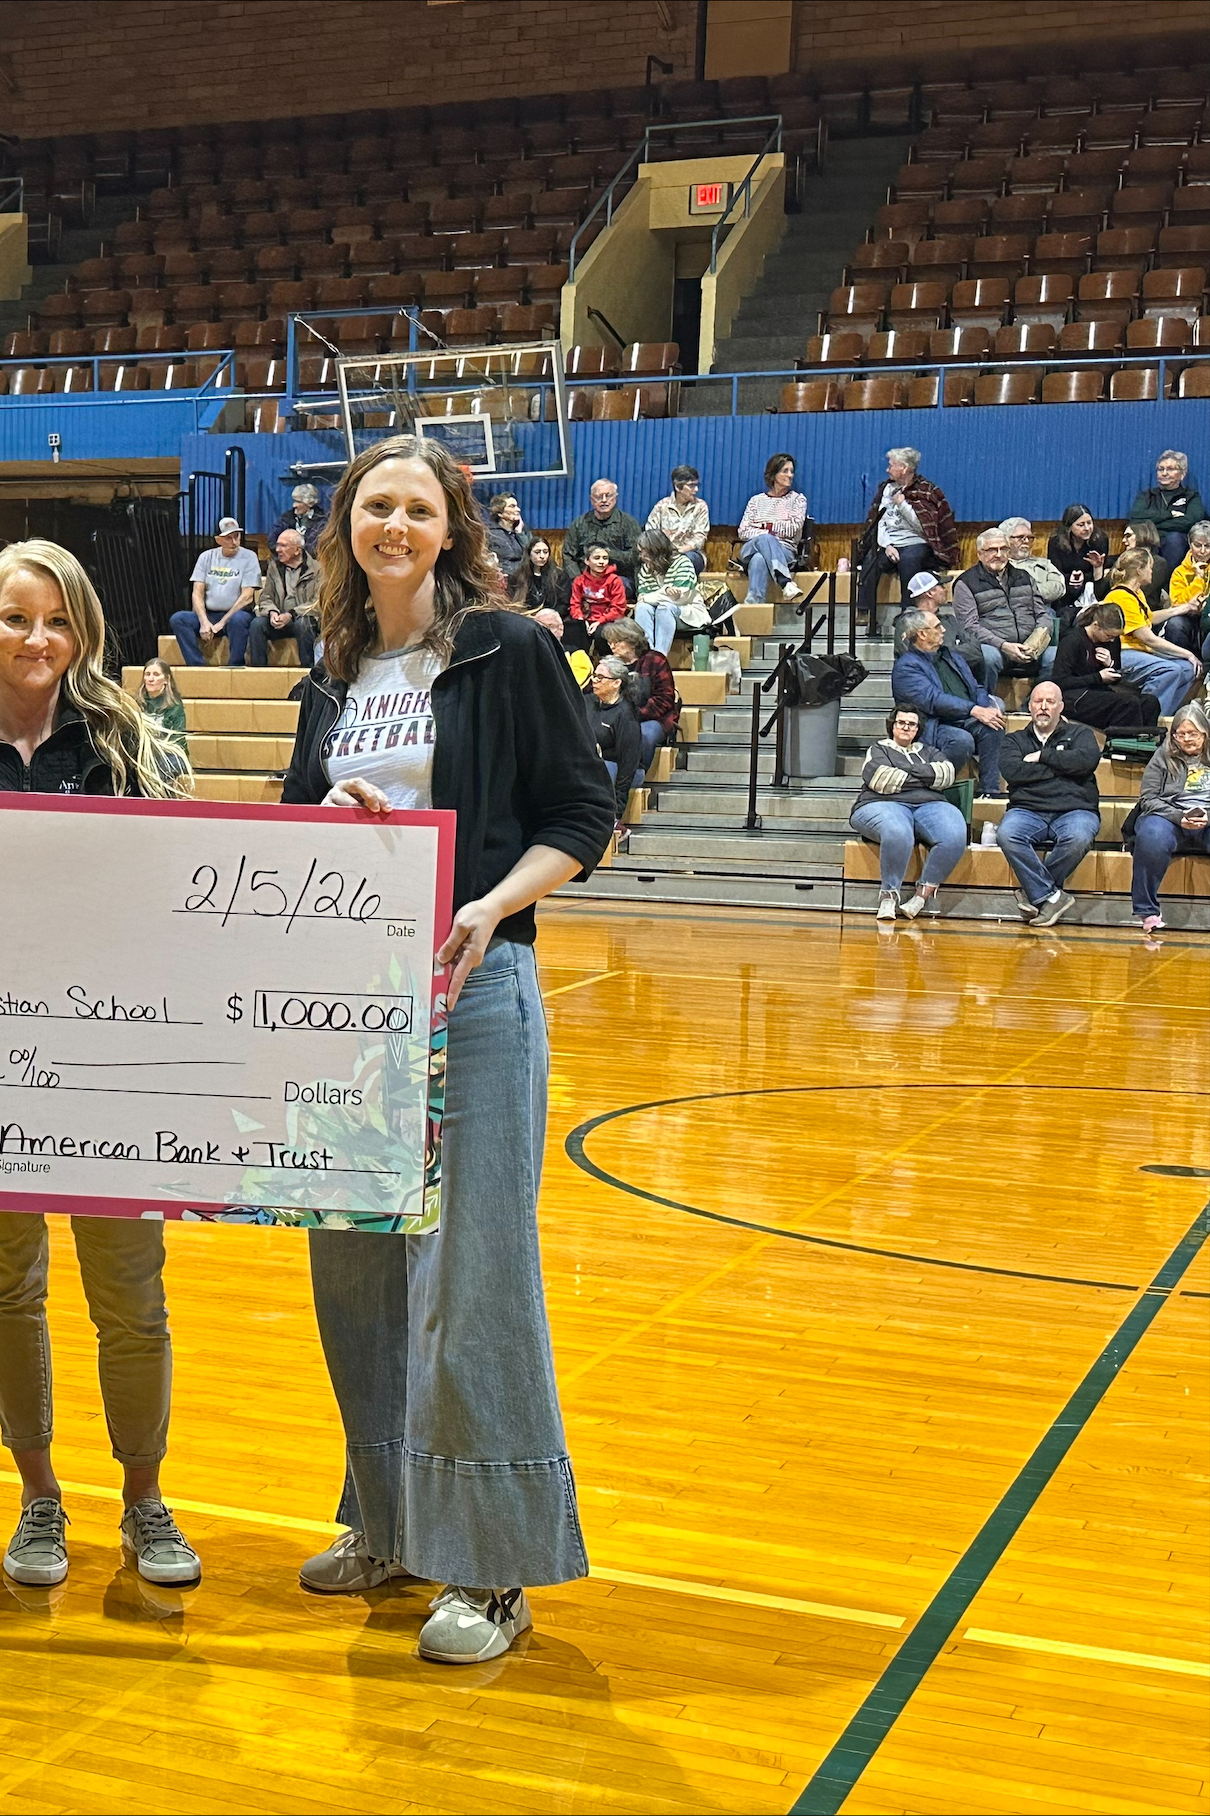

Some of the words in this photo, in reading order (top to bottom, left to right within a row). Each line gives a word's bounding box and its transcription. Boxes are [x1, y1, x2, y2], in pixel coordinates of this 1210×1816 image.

[697, 184, 722, 206] EXIT
[361, 691, 430, 721] KNIGH
[321, 719, 435, 760] SKETBAL
[185, 855, 381, 933] 2/5/26
[387, 924, 416, 938] Date
[66, 985, 170, 1023] School
[226, 992, 244, 1024] $
[262, 993, 409, 1031] 1,000.00
[284, 1081, 363, 1106] Dollars
[155, 1131, 221, 1163] Bank
[253, 1141, 333, 1170] Trust
